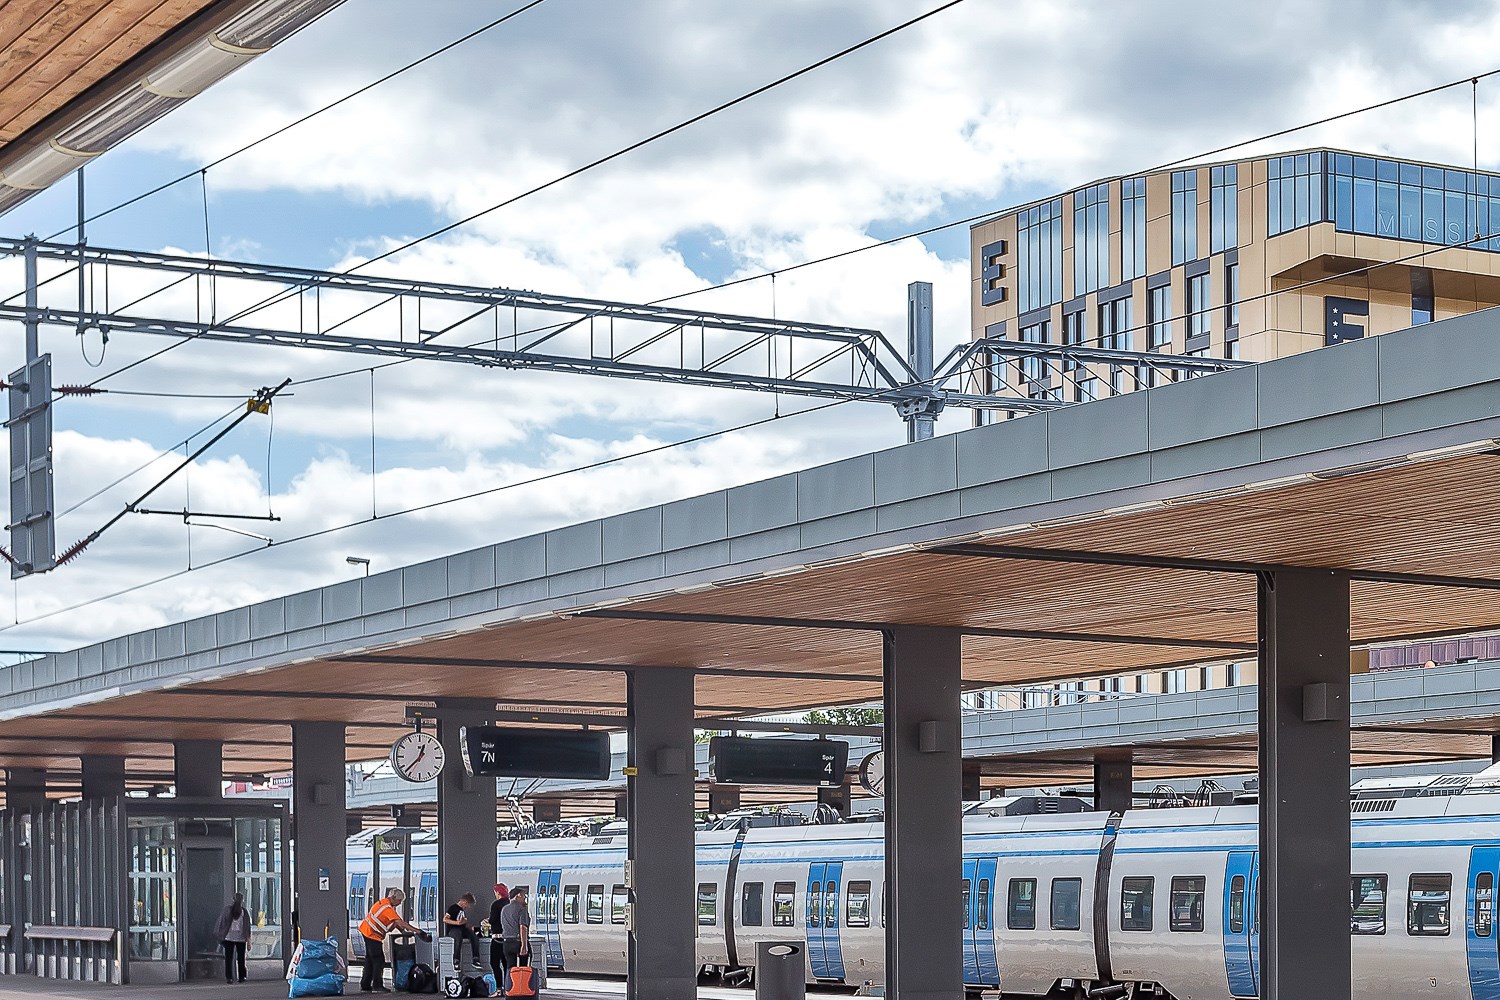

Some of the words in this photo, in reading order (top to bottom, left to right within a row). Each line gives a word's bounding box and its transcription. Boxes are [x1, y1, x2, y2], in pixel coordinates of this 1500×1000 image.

[981, 240, 1008, 307] E
[481, 750, 495, 763] 7N
[823, 761, 833, 775] 4
